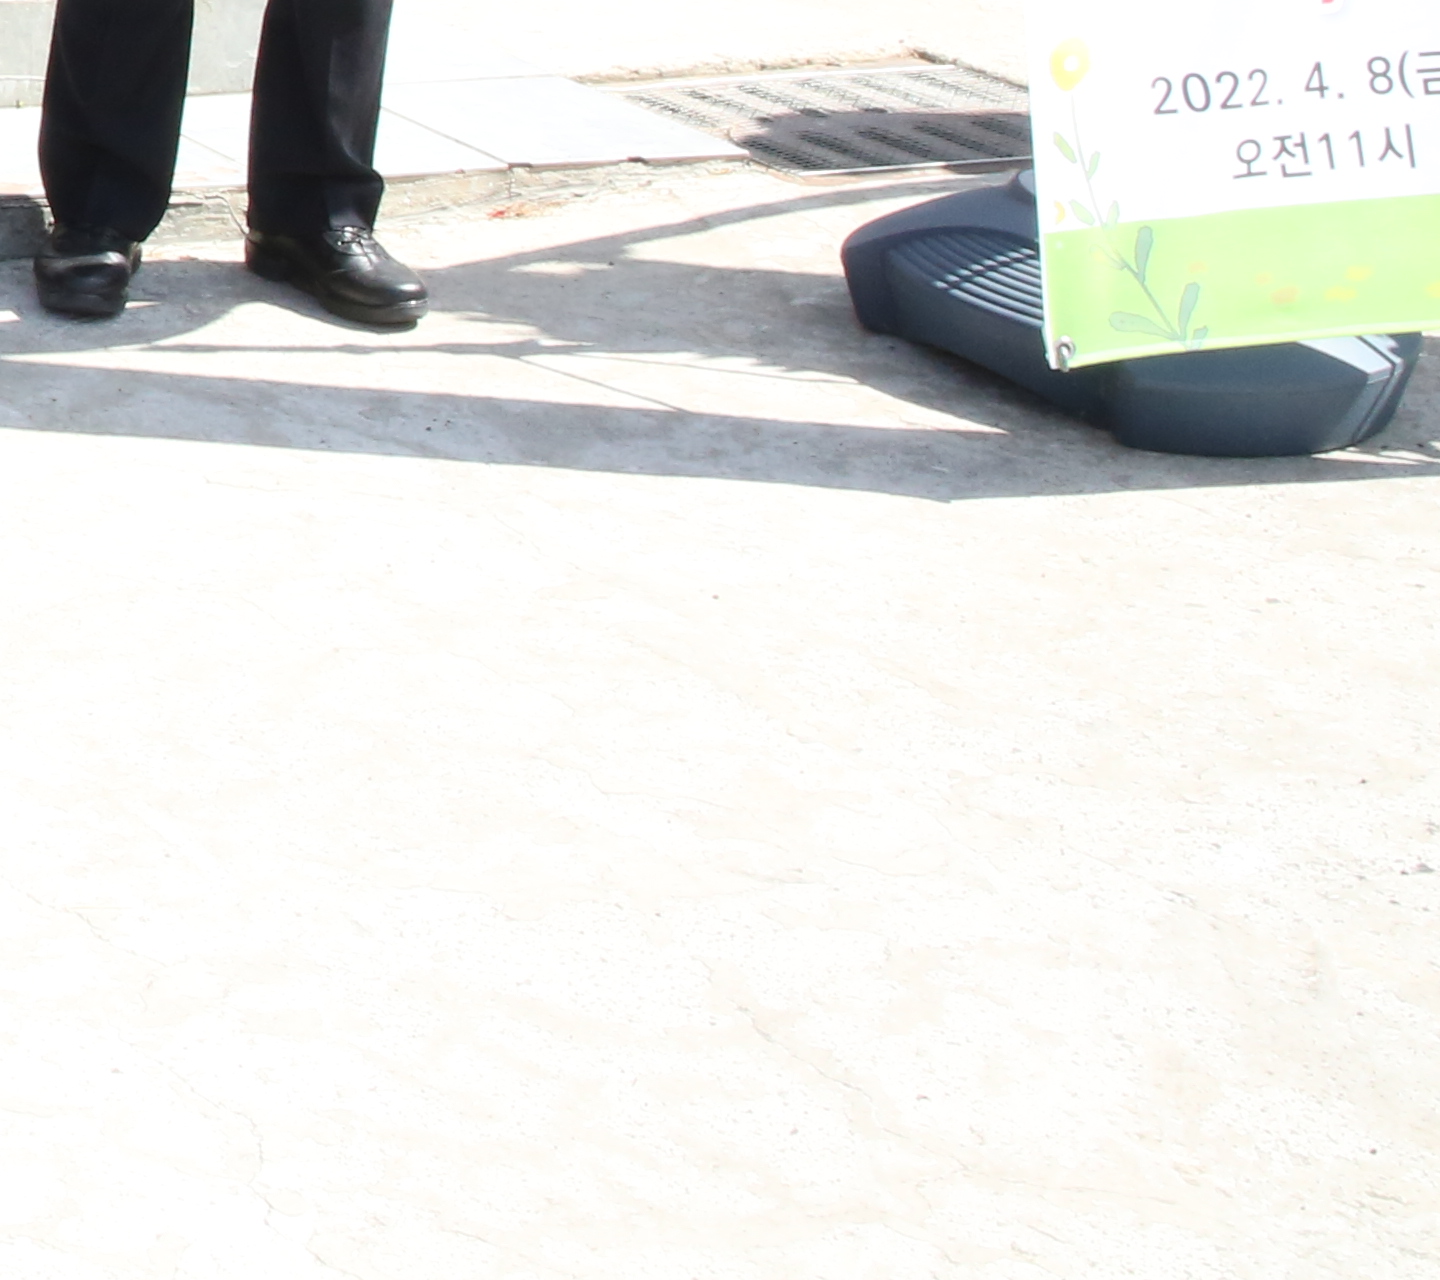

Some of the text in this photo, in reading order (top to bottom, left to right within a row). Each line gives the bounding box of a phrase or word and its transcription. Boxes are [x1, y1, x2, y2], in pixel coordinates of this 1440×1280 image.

[1151, 67, 1284, 115] 2022.
[1304, 61, 1345, 100] 4.
[1232, 123, 1417, 180] 오전11시
